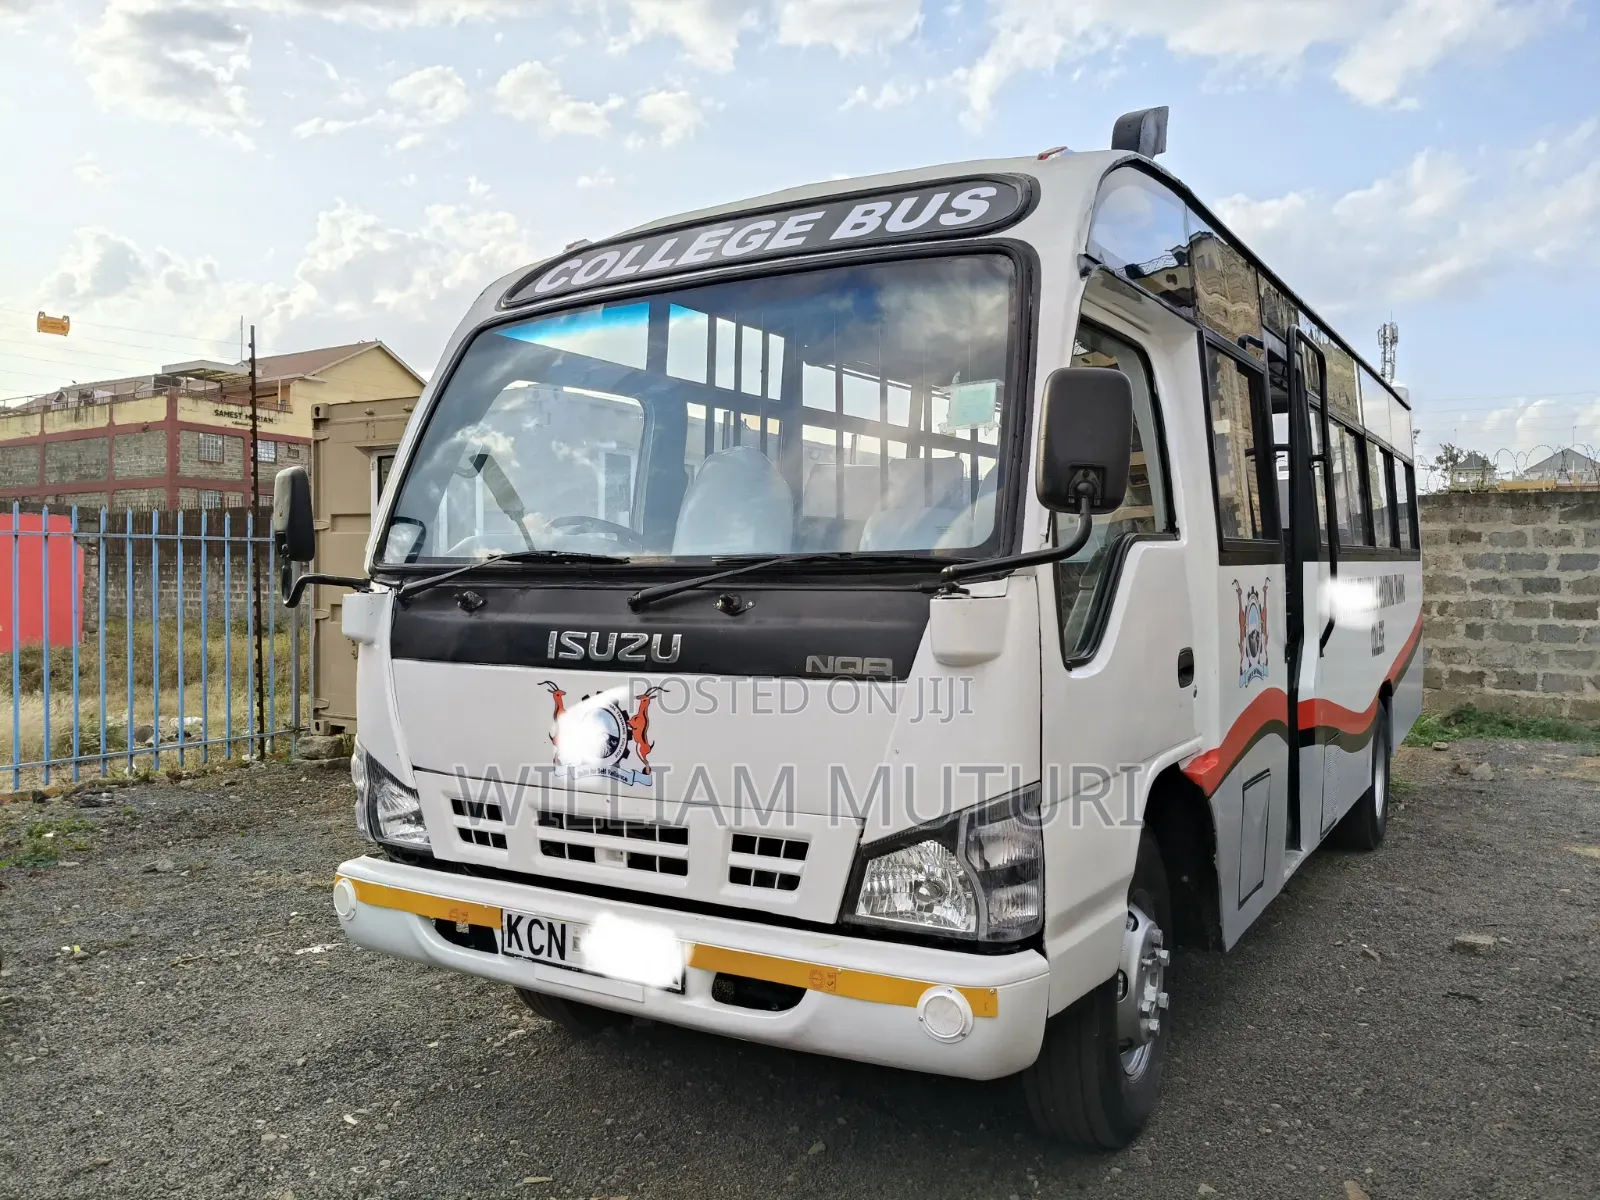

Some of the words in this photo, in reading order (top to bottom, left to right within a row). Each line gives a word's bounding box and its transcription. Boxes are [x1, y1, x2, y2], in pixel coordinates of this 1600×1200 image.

[534, 210, 825, 293] COLLEGE
[830, 186, 998, 240] BUS
[245, 413, 274, 423] MRIAN
[546, 630, 683, 663] ISUZU
[507, 913, 566, 960] KCN
